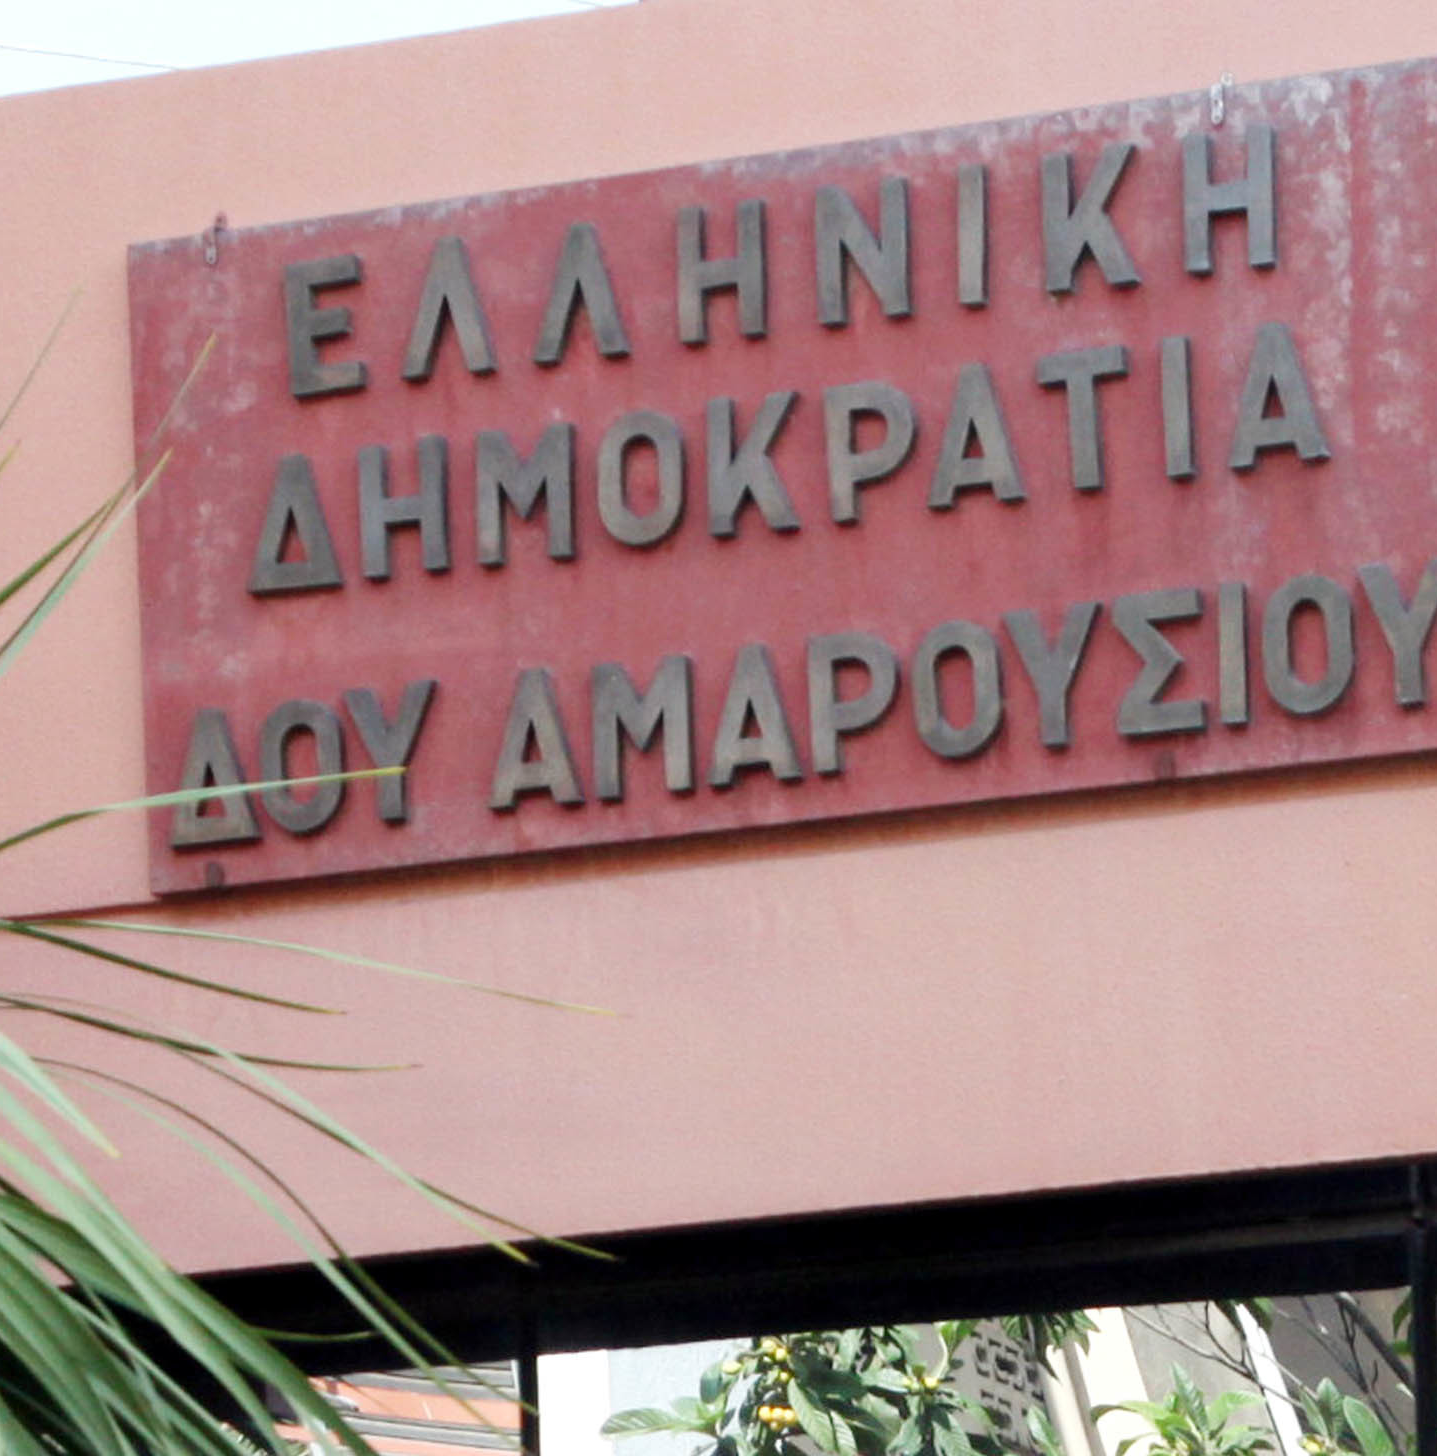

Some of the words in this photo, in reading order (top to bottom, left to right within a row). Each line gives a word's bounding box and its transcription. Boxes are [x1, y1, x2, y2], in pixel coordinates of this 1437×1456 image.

[281, 125, 1278, 401] ΕΛΛΗΝΙΚΗ
[246, 321, 1332, 598] ΔΗΜΟΚΡΑΤΙΑ
[170, 678, 437, 853] ΔΟΥ
